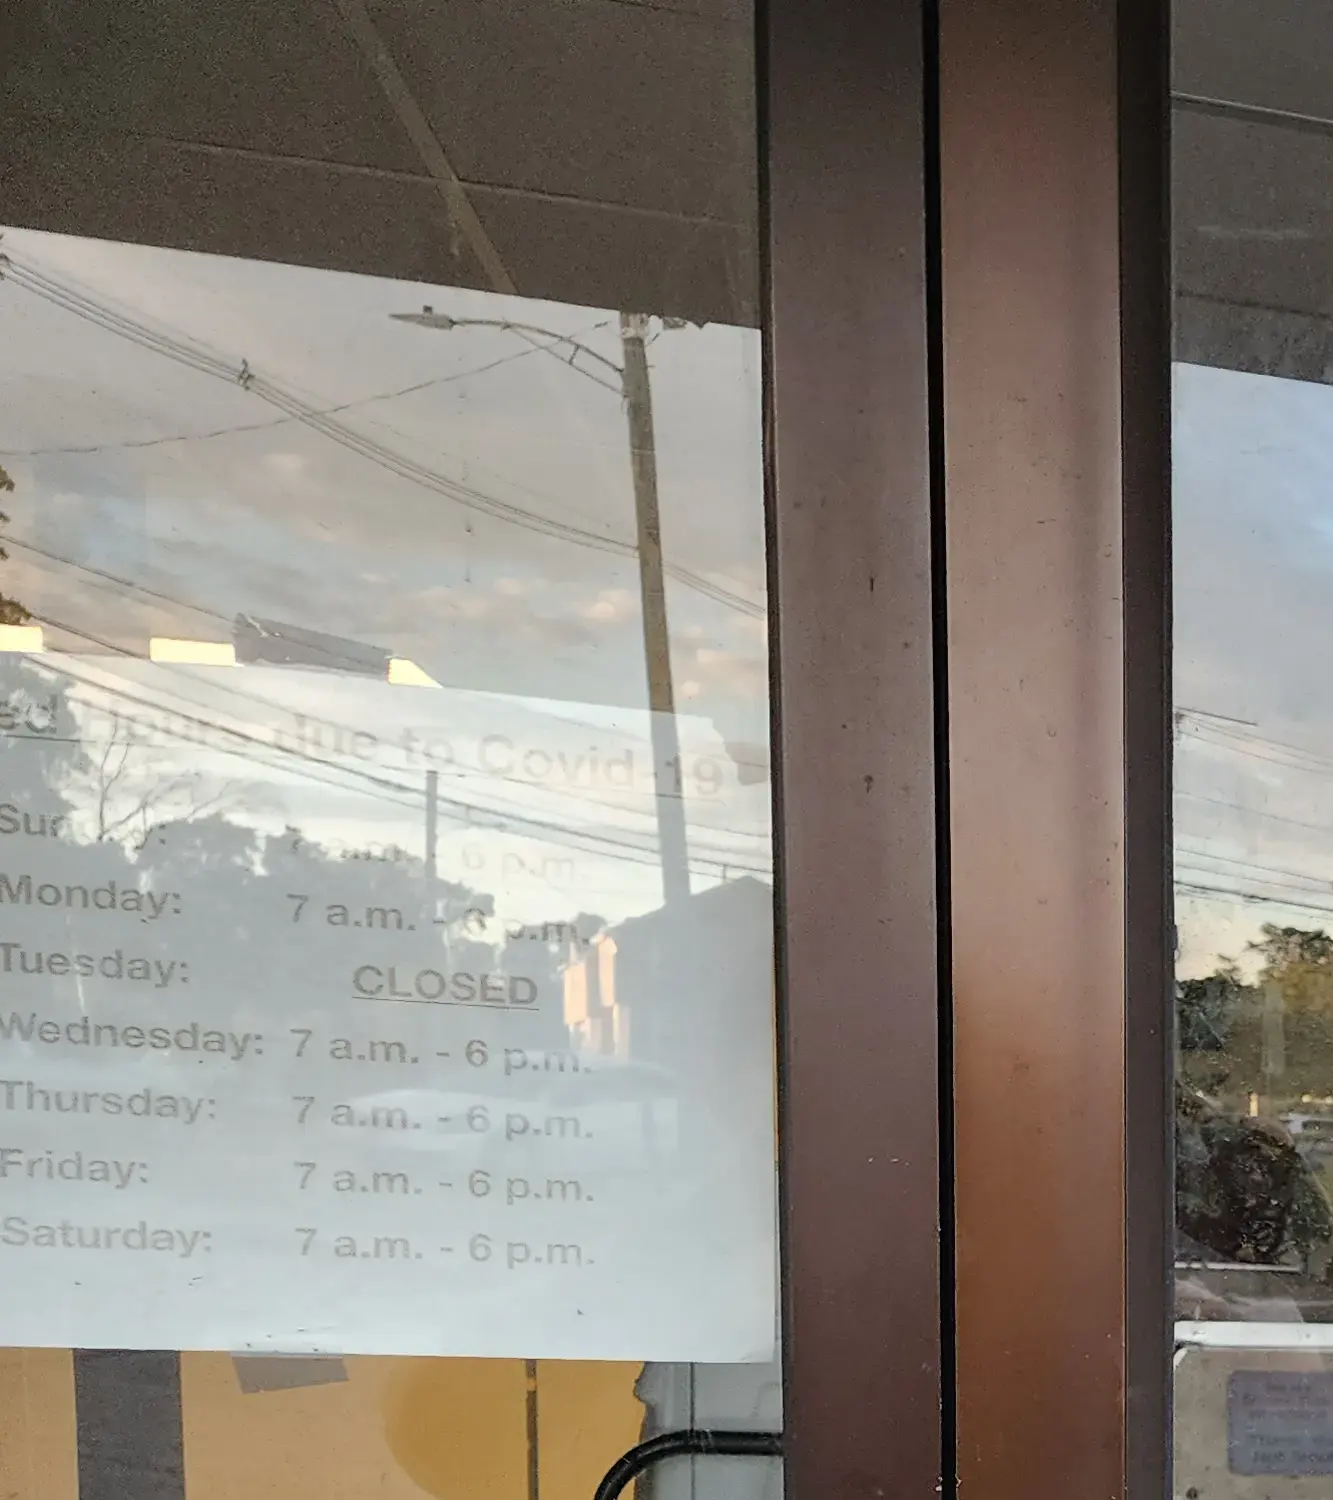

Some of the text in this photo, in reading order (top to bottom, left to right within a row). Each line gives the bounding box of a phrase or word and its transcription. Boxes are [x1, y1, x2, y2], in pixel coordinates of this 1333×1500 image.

[0, 873, 182, 920] Monday:
[286, 894, 309, 923] 7
[326, 903, 416, 931] a.m.
[0, 942, 538, 1006] Tuesday: CLOSED
[0, 1012, 264, 1061] Wednesday:
[290, 1029, 312, 1057] 7
[329, 1038, 419, 1064] a.m.
[465, 1040, 488, 1067] 6
[503, 1047, 592, 1076] p.m.
[0, 1080, 216, 1125] Thursday:
[292, 1096, 315, 1124] 7
[331, 1104, 421, 1130] a.m.
[467, 1105, 490, 1133] 6
[505, 1112, 593, 1141] p.m.
[0, 1148, 148, 1189] Friday:
[293, 1161, 316, 1190] 7
[333, 1169, 422, 1195] a.m.
[468, 1169, 491, 1197] 6
[506, 1177, 594, 1205] p.m.
[0, 1216, 212, 1258] Saturday:
[295, 1227, 317, 1256] 7
[334, 1235, 423, 1260] a.m.
[469, 1233, 493, 1262] 6
[507, 1241, 596, 1269] p.m.
